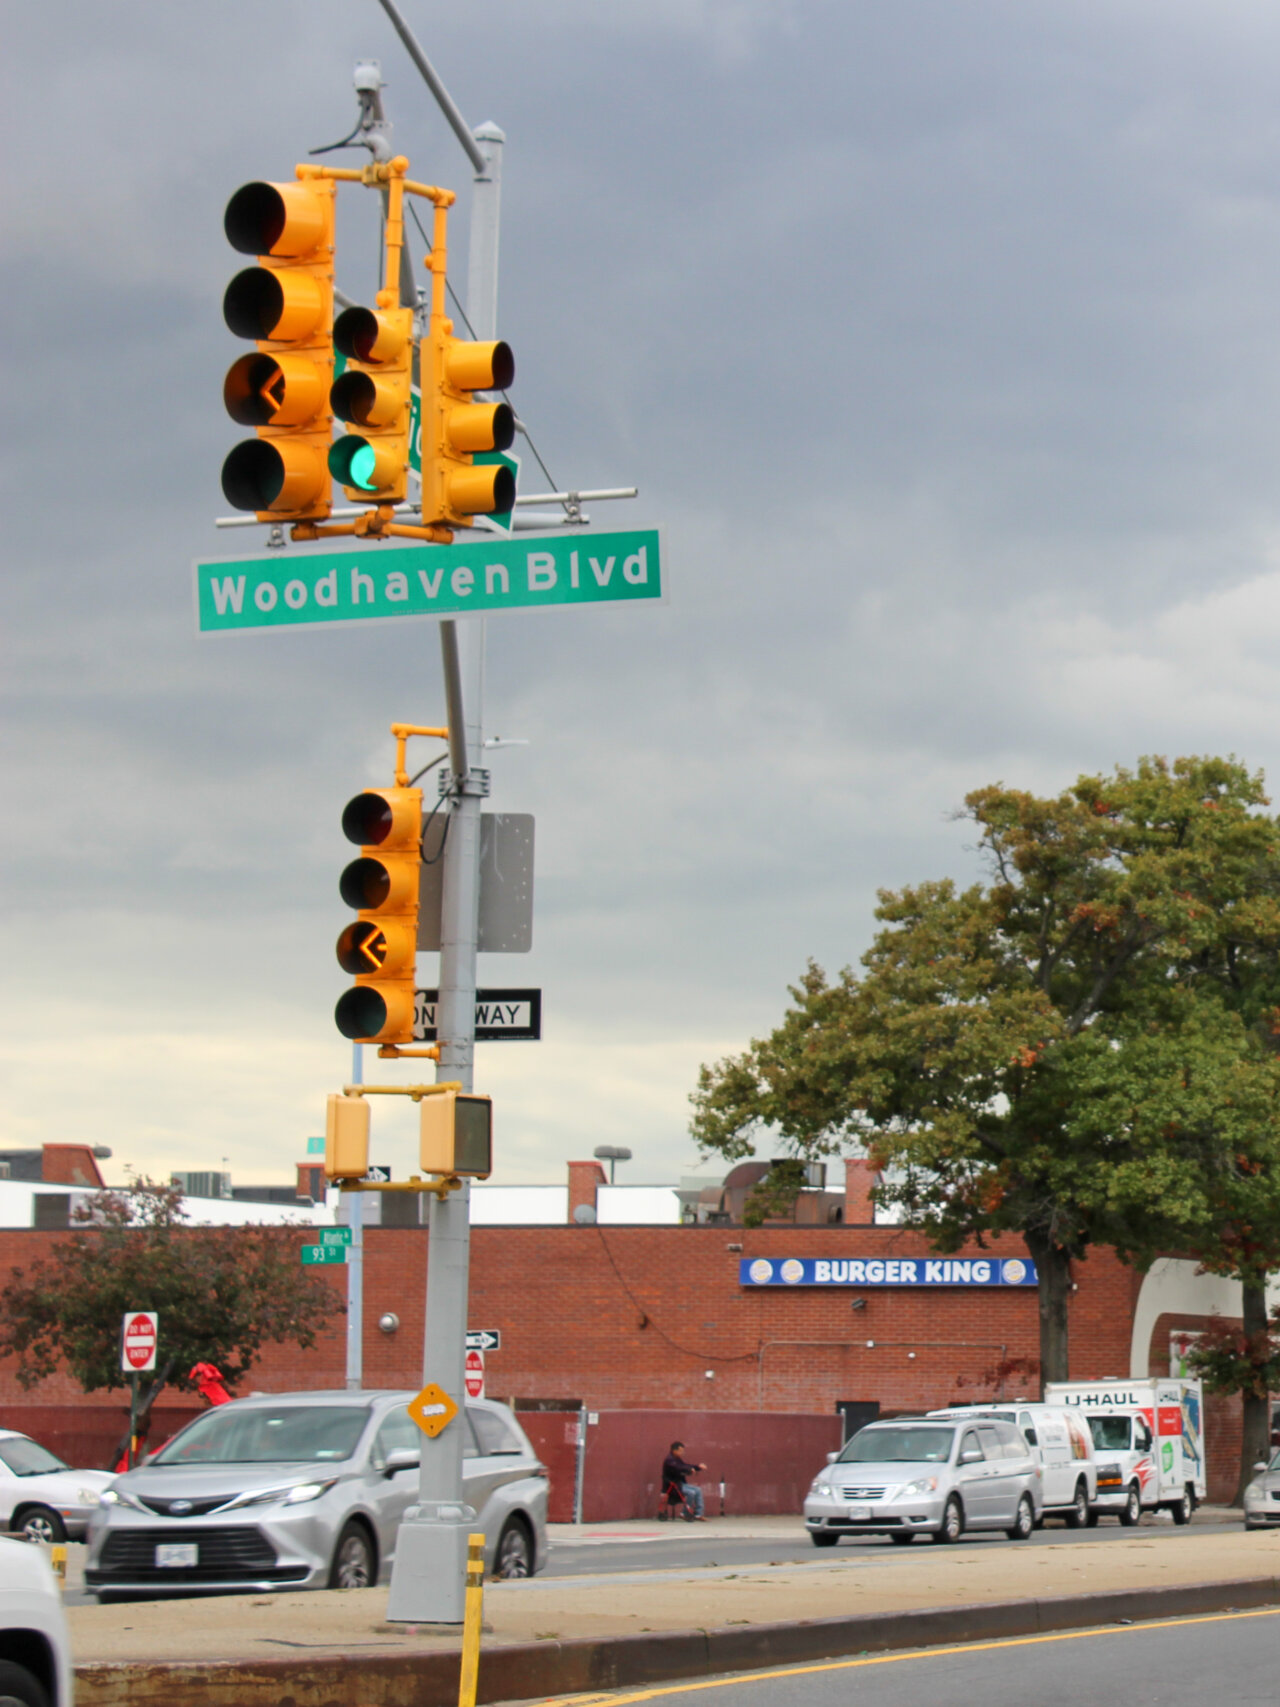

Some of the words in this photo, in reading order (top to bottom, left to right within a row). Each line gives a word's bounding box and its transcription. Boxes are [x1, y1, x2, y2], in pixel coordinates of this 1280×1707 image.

[210, 562, 510, 615] Woodhaven
[526, 545, 648, 592] Blvd
[475, 1005, 520, 1025] WAY
[312, 1247, 325, 1262] 93
[815, 1261, 917, 1282] BURGER
[925, 1261, 991, 1282] KING
[130, 1324, 138, 1334] DO
[140, 1323, 152, 1333] NOT
[130, 1349, 148, 1358] ENTER
[1065, 1393, 1138, 1406] U-HAUL
